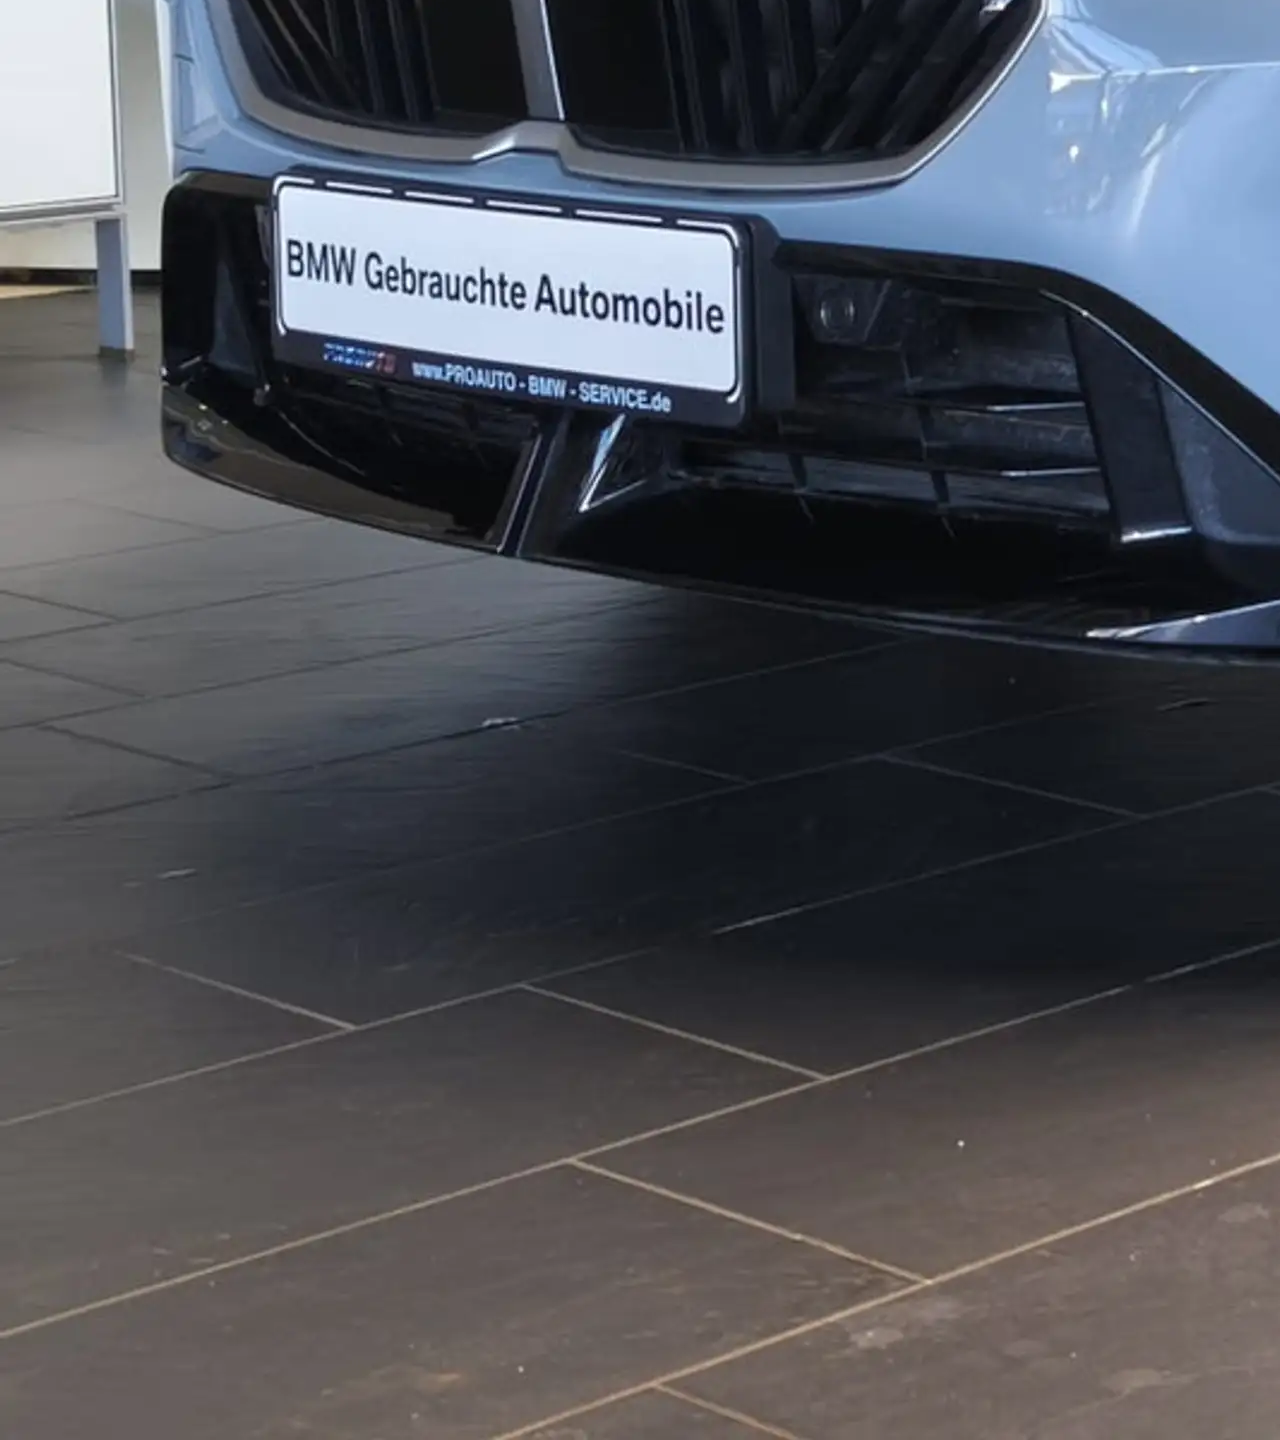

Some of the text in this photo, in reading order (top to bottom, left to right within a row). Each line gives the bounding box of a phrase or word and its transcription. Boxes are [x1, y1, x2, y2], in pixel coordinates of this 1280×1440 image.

[286, 238, 725, 335] BMW Gebrauchte Automobile
[527, 374, 567, 399] BMW
[578, 381, 672, 413] SERVICE.de
